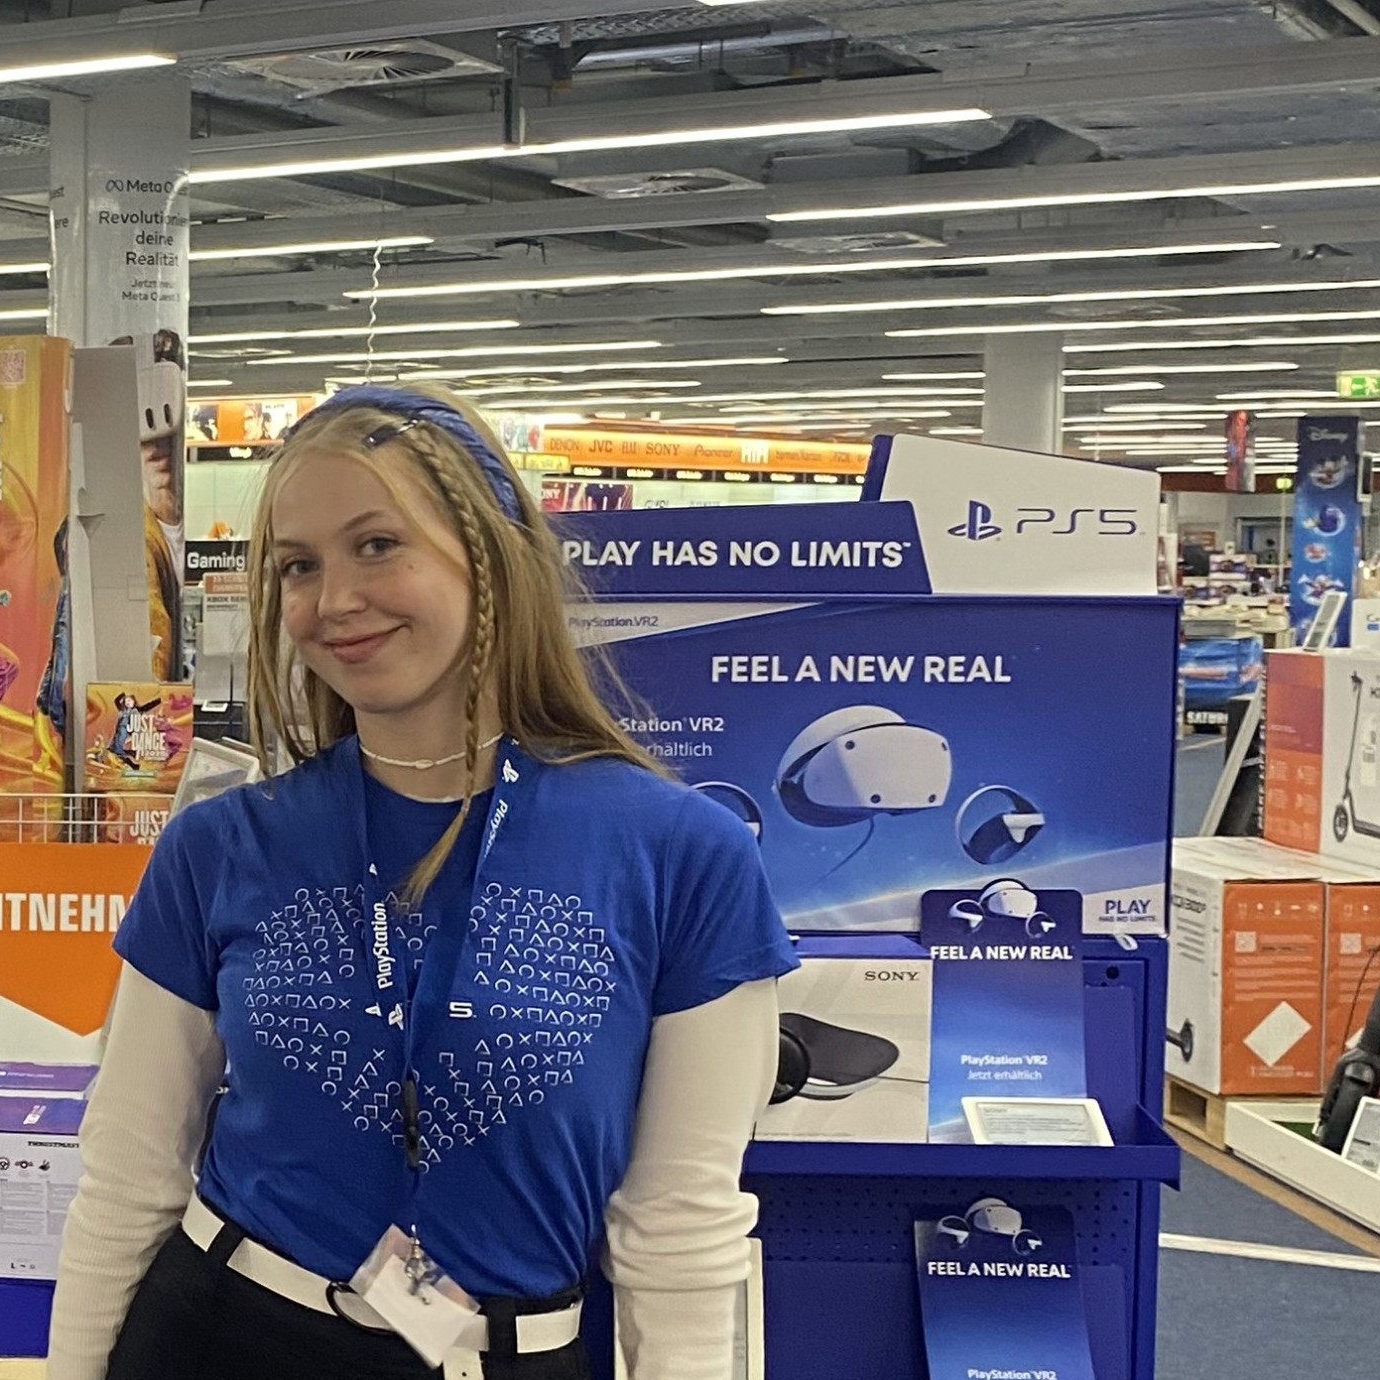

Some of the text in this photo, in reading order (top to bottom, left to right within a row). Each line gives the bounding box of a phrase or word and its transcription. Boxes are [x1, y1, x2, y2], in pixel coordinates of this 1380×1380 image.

[126, 180, 163, 193] Meta
[135, 230, 174, 246] deine
[125, 251, 180, 267] Realität
[589, 440, 613, 453] JVC
[645, 442, 680, 456] SONY
[1016, 507, 1139, 535] PS5
[187, 551, 246, 571] Gaming
[562, 540, 640, 567] PLAY
[652, 540, 719, 567] HAS
[729, 540, 782, 567] NO
[711, 655, 1012, 684] FEEL A NEW REAL
[126, 714, 156, 733] JUST
[619, 716, 725, 733] Station VR2
[1187, 711, 1229, 725] SATUR
[131, 731, 168, 753] DANCE
[645, 741, 713, 757] rhältlich
[1105, 899, 1152, 914] PLAY
[370, 902, 396, 990] PlayStation
[929, 945, 1073, 961] FEEL A NEW REAL
[863, 970, 920, 983] SONY
[960, 1054, 1049, 1067] PlayStation VR2
[926, 1261, 1071, 1278] FEEL A NEW REAL
